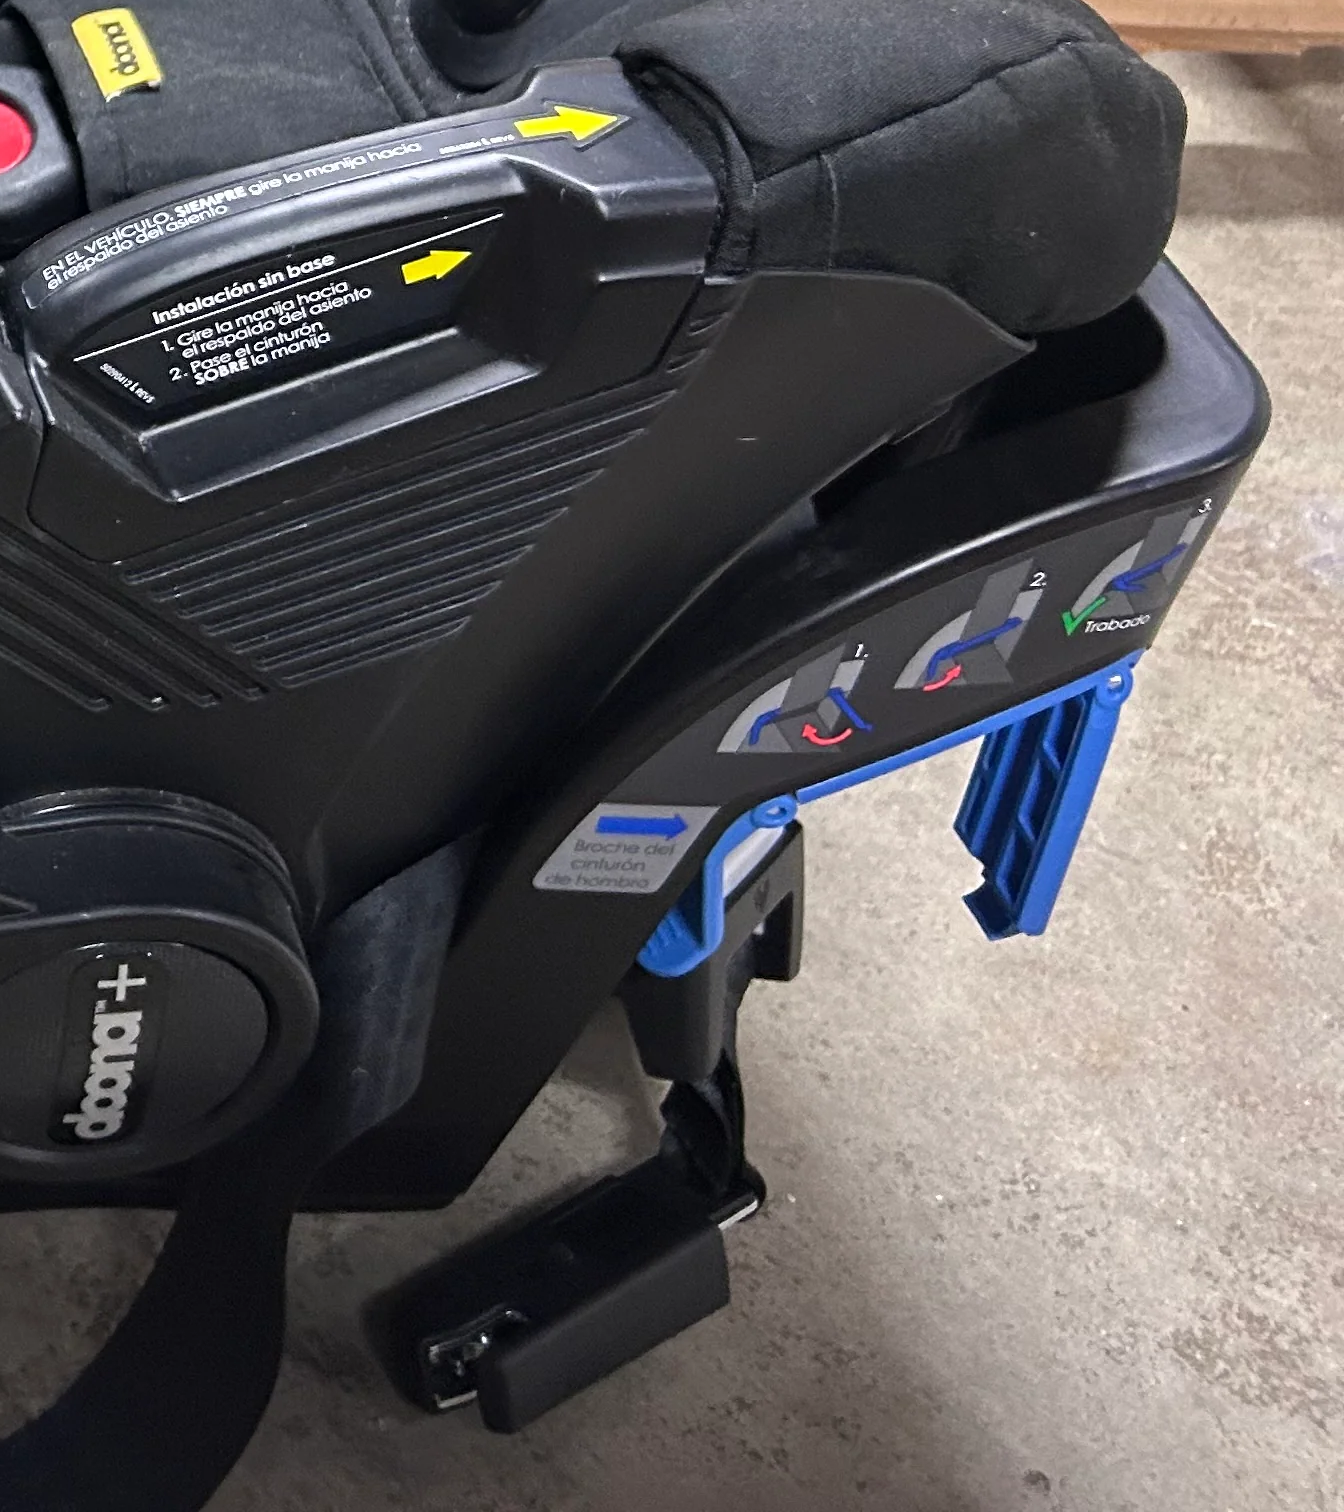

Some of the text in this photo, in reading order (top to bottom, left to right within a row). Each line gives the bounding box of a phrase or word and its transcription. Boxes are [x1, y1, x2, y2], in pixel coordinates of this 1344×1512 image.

[98, 22, 140, 76] doona
[42, 259, 66, 281] EN
[64, 250, 86, 266] EL
[173, 184, 247, 220] SIEMPRE
[246, 176, 283, 196] gire
[282, 170, 302, 184] la
[304, 150, 368, 181] manija
[366, 135, 422, 164] hacia
[45, 202, 230, 290] el respaldo del asiento
[151, 253, 336, 324] Instalación sin base
[160, 280, 349, 352] 1. Gire la manija hacia
[180, 286, 372, 358] el respaldo del asiento
[168, 319, 324, 382] 2. Pase el cinturón
[193, 330, 331, 386] SOBRE la manija
[1030, 572, 1047, 587] 2.
[854, 644, 868, 658] 1.
[1084, 614, 1151, 632] Trabado
[570, 858, 646, 872] cinturón
[574, 839, 676, 856] Broche del
